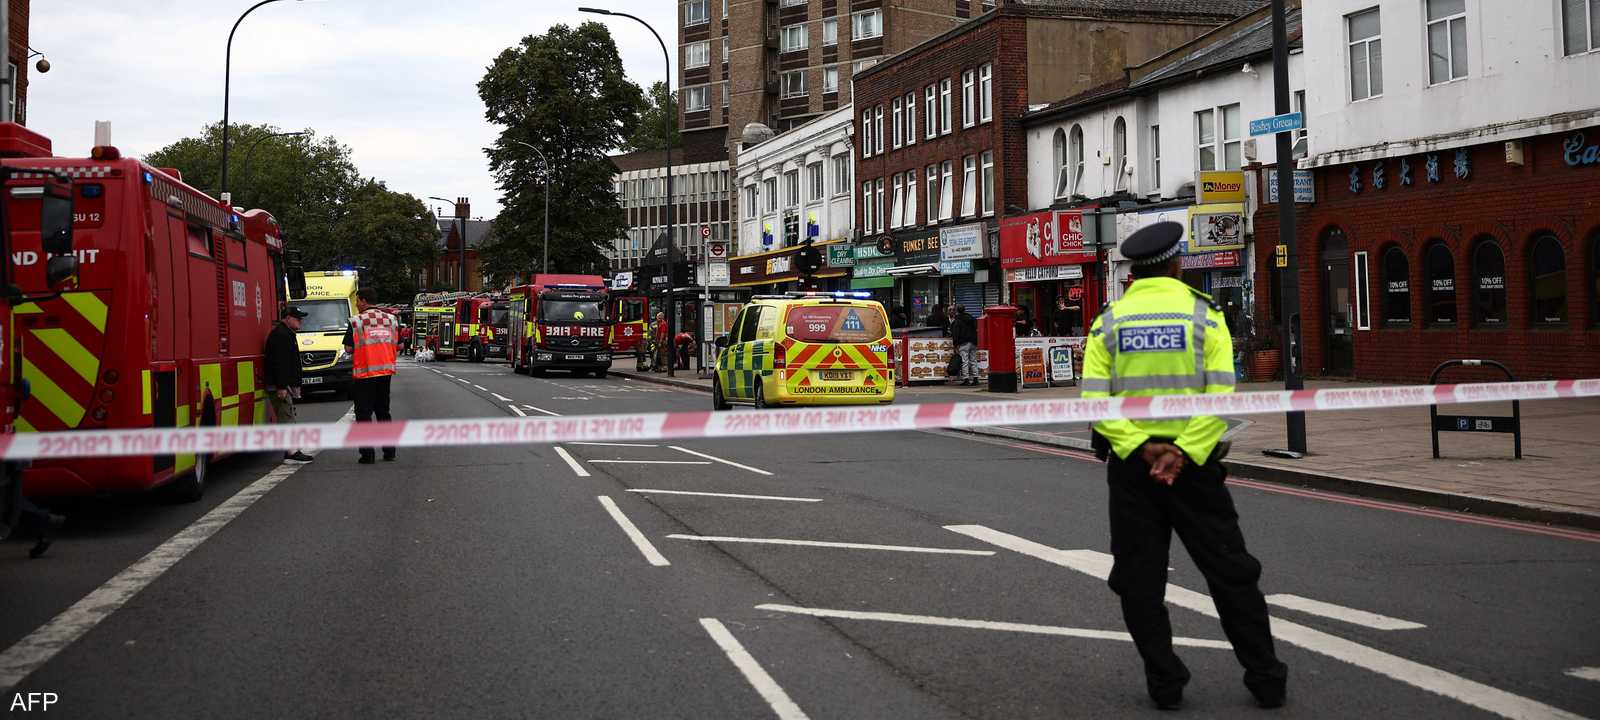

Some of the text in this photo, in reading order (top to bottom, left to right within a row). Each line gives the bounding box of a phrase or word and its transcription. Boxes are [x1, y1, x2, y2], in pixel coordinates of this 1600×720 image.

[1250, 120, 1271, 133] Rushey
[1273, 118, 1293, 129] Green
[1214, 182, 1240, 192] Money
[89, 213, 100, 221] 12
[702, 228, 710, 236] G
[1062, 233, 1083, 241] CHIC
[903, 238, 925, 253] FUNKEY
[927, 236, 939, 250] BEE
[836, 250, 848, 258] DRY
[831, 257, 855, 265] CLEANING
[1389, 280, 1408, 289] 10% OFF
[1433, 278, 1453, 287] 10% OFF
[1481, 276, 1502, 285] 10% OFF
[808, 323, 827, 332] 999
[845, 320, 860, 329] 111
[580, 327, 605, 337] FIRE
[1121, 327, 1182, 337] METROPOLITAN
[1121, 334, 1182, 350] POLICE
[871, 344, 887, 352] NHS
[794, 386, 826, 394] LONDON
